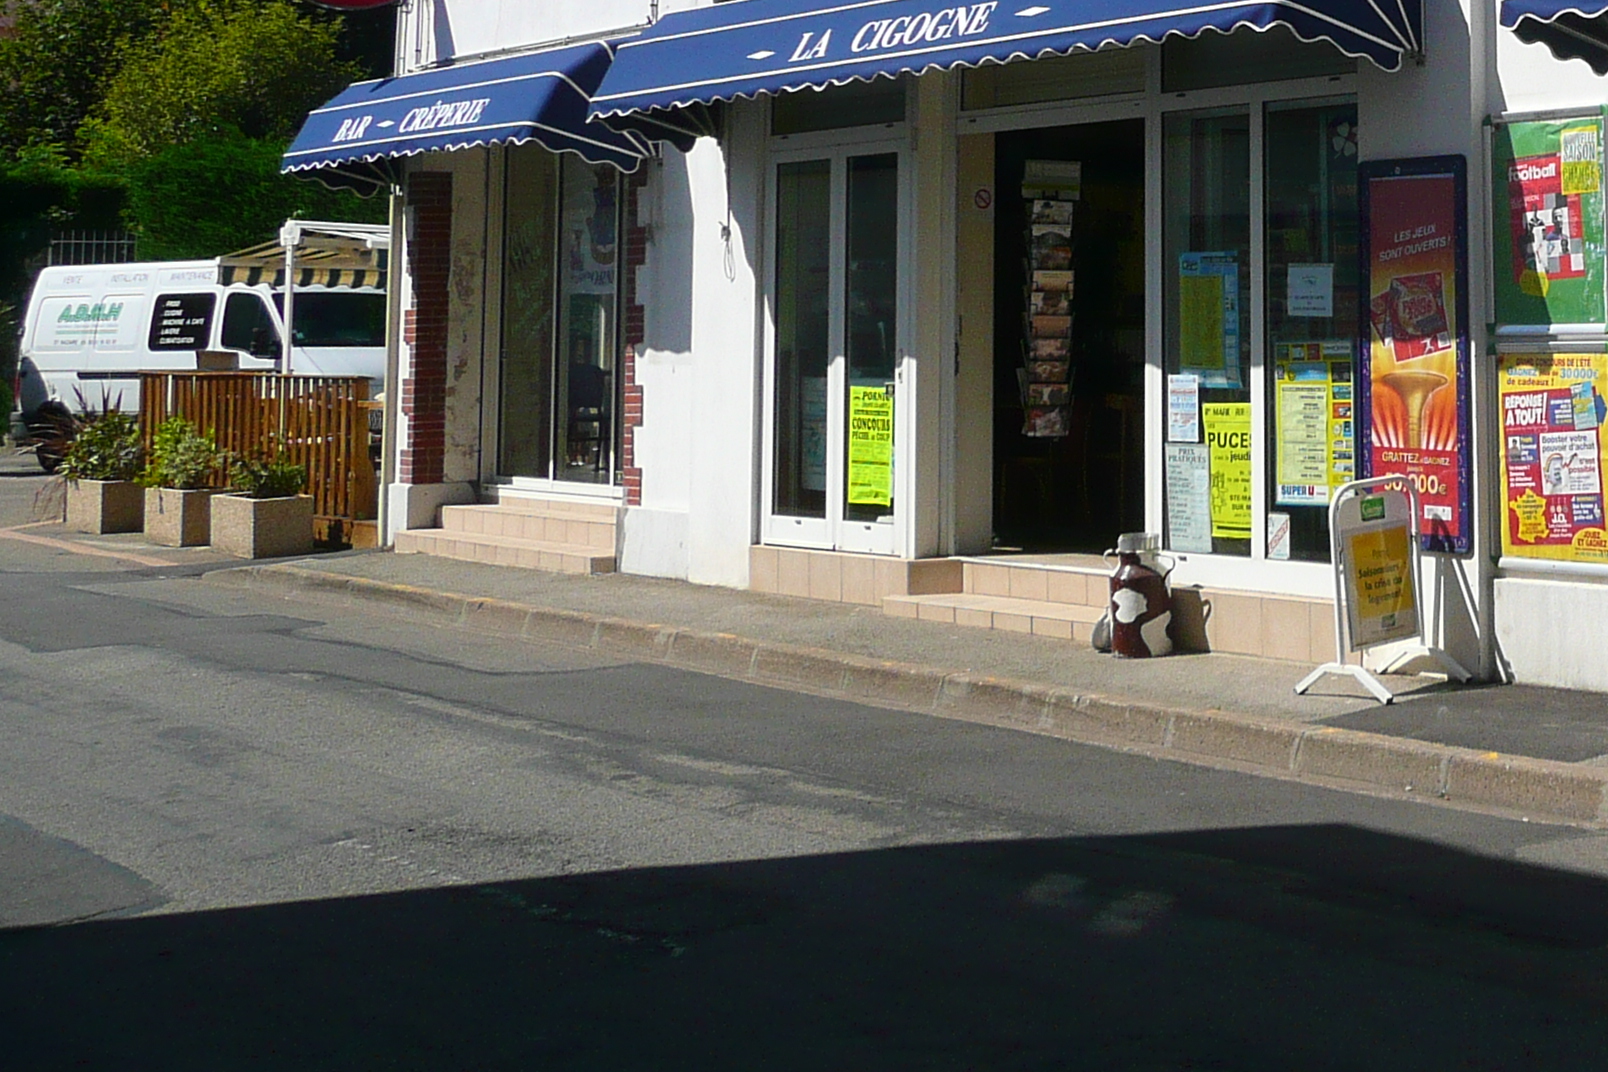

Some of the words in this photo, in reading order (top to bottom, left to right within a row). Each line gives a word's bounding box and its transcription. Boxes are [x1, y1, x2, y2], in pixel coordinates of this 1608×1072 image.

[788, 28, 832, 62] LA
[851, 1, 998, 53] CIGOGNE
[332, 115, 372, 142] BAR
[1563, 142, 1596, 161] SAISON
[1508, 163, 1556, 183] football
[1394, 230, 1411, 243] LES
[1412, 224, 1436, 239] JEUX
[1379, 247, 1403, 261] SONT
[1518, 378, 1549, 386] cadeaux
[852, 417, 890, 432] CONCOURS
[1208, 431, 1251, 449] PUCE
[1570, 434, 1587, 442] votre
[1382, 451, 1419, 464] GRATTEZ
[1281, 484, 1307, 496] SUPER
[1308, 484, 1315, 496] U
[1364, 579, 1373, 590] la
